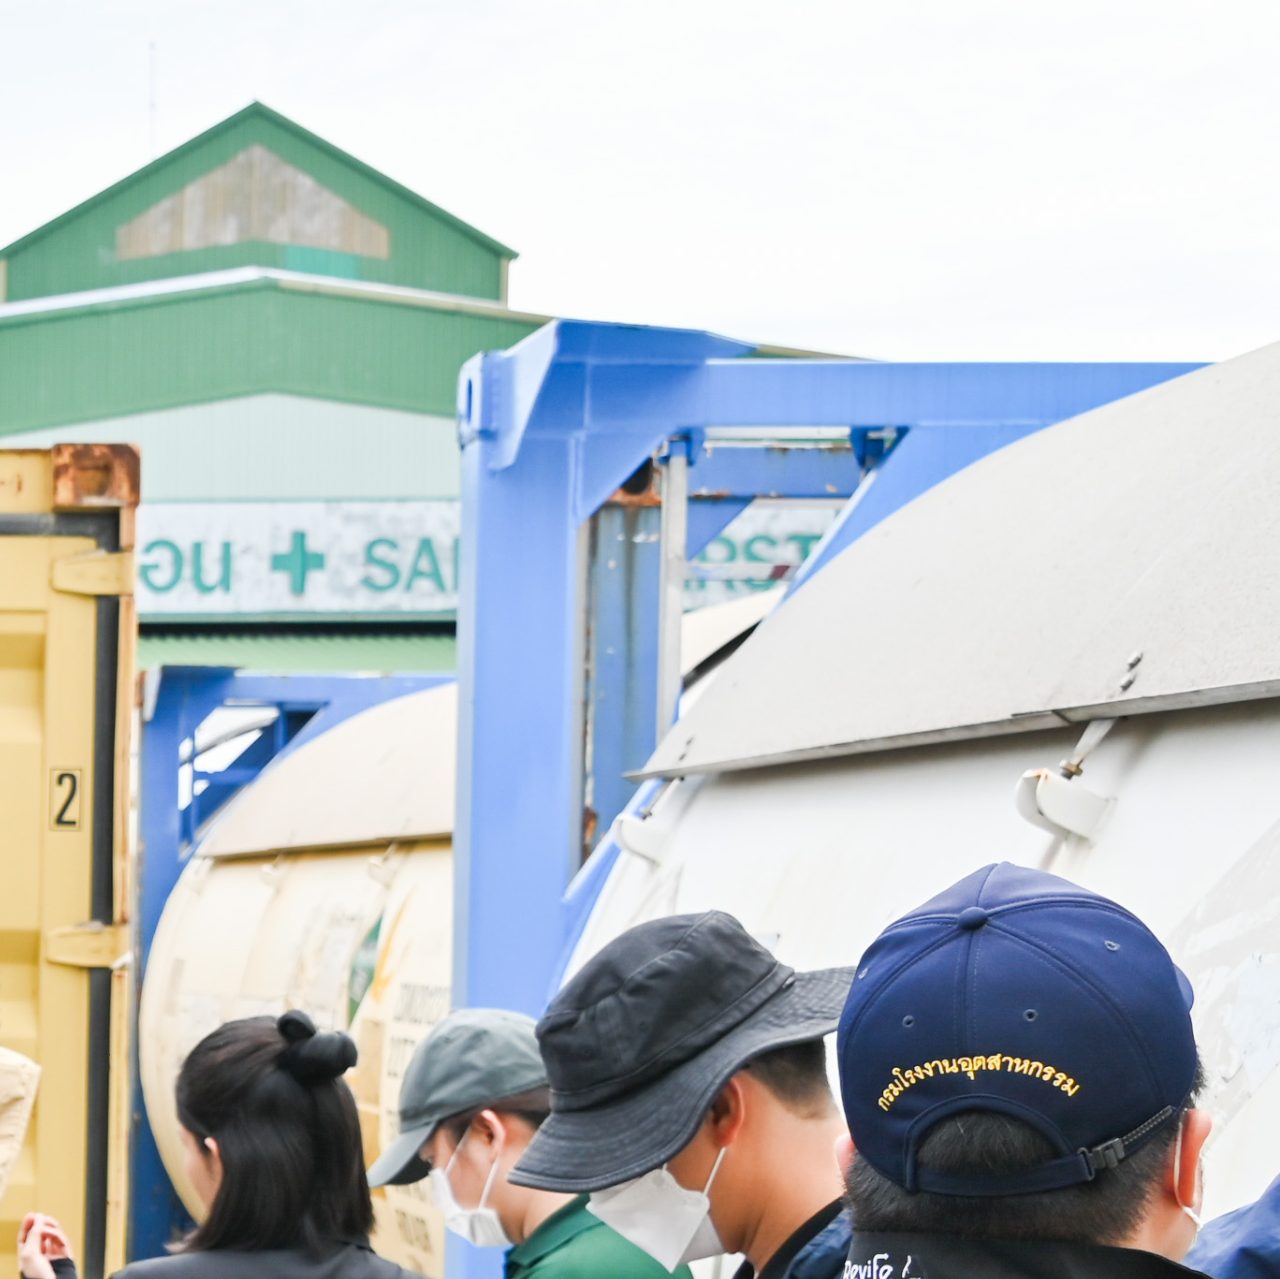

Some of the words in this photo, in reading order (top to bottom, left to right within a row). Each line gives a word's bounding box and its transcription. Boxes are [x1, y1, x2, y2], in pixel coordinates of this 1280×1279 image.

[54, 772, 78, 827] 2
[877, 1053, 1080, 1111] กรมโรงงานอุตสาหกรรม
